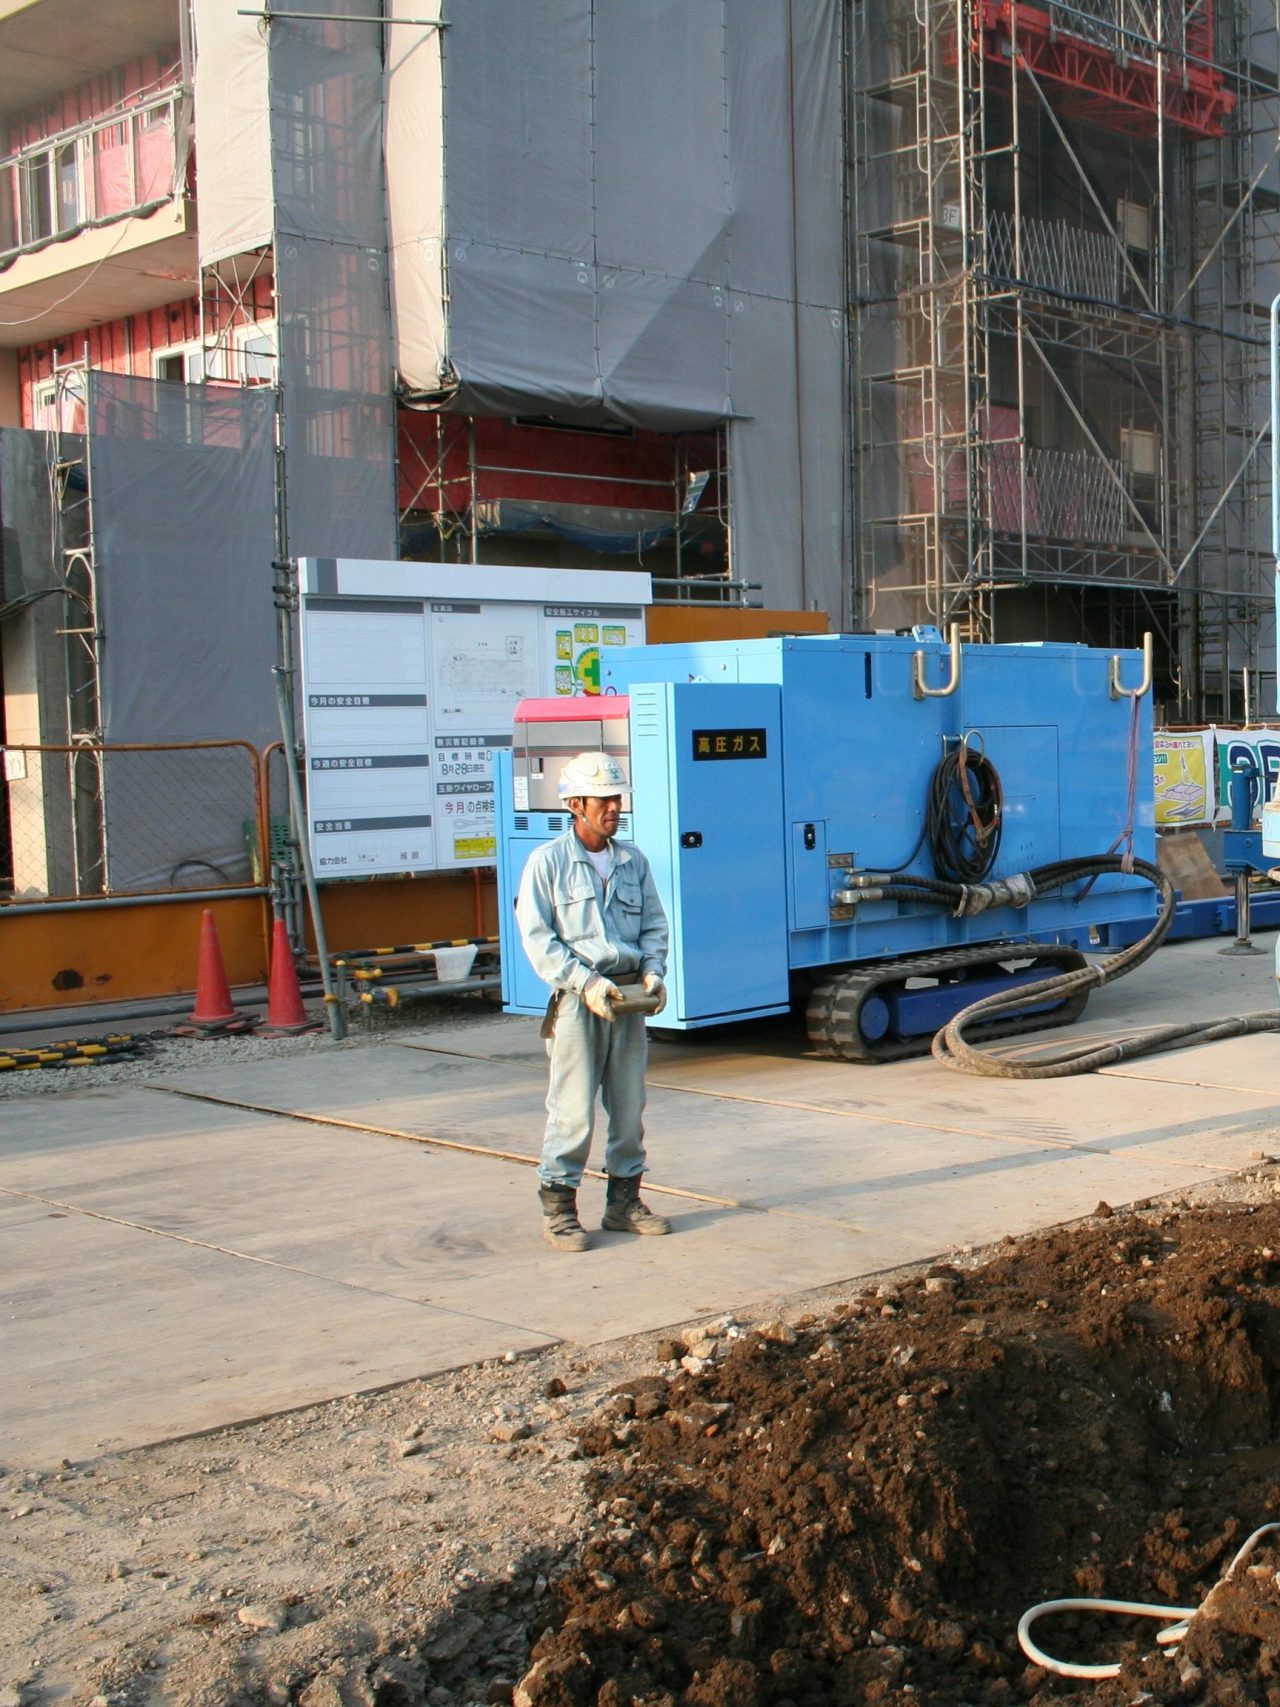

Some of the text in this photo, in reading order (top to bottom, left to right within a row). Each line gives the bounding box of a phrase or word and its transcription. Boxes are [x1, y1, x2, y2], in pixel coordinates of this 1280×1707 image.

[310, 696, 370, 706] 今月の安全目標
[698, 735, 761, 753] 高圧ガス
[313, 758, 373, 769] 今週の安全目標
